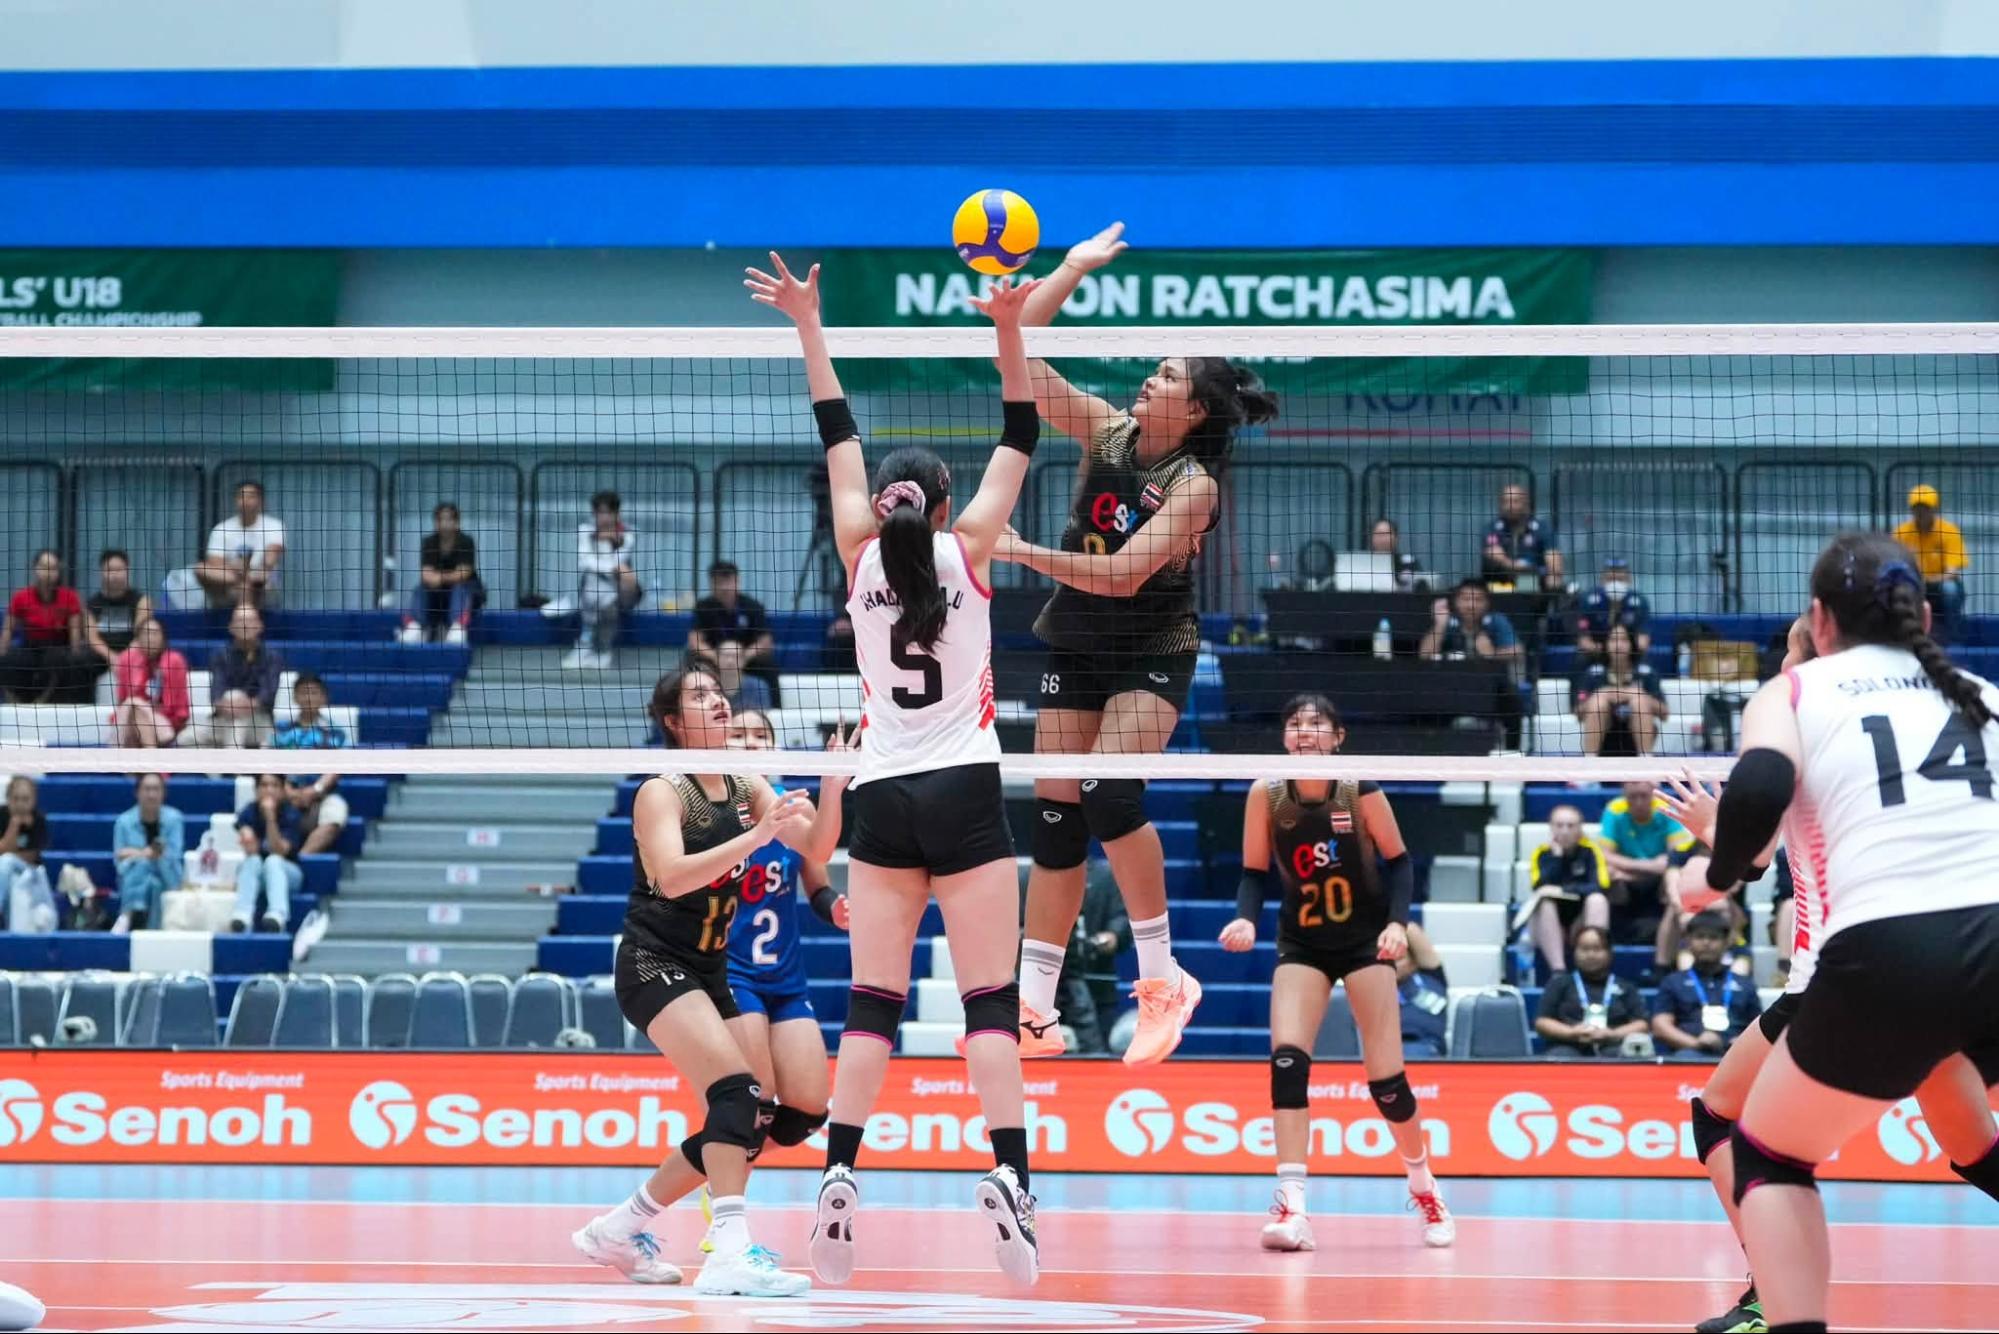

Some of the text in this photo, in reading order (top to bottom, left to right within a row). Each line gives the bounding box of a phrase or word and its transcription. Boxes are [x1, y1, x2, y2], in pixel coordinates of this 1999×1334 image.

[53, 276, 122, 307] U18
[1152, 275, 1515, 319] RATCHASIMA
[890, 624, 943, 710] 5
[1861, 710, 1996, 808] 14
[741, 856, 791, 904] est
[1293, 838, 1340, 878] est
[698, 895, 738, 952] 13
[1298, 875, 1353, 928] 20
[752, 908, 779, 965] 2
[160, 1070, 304, 1090] Sports Equipment
[535, 1072, 680, 1092] Sports Equipment
[911, 1077, 964, 1096] Sports
[51, 1091, 312, 1146] Senoh
[424, 1093, 689, 1148] Senoh
